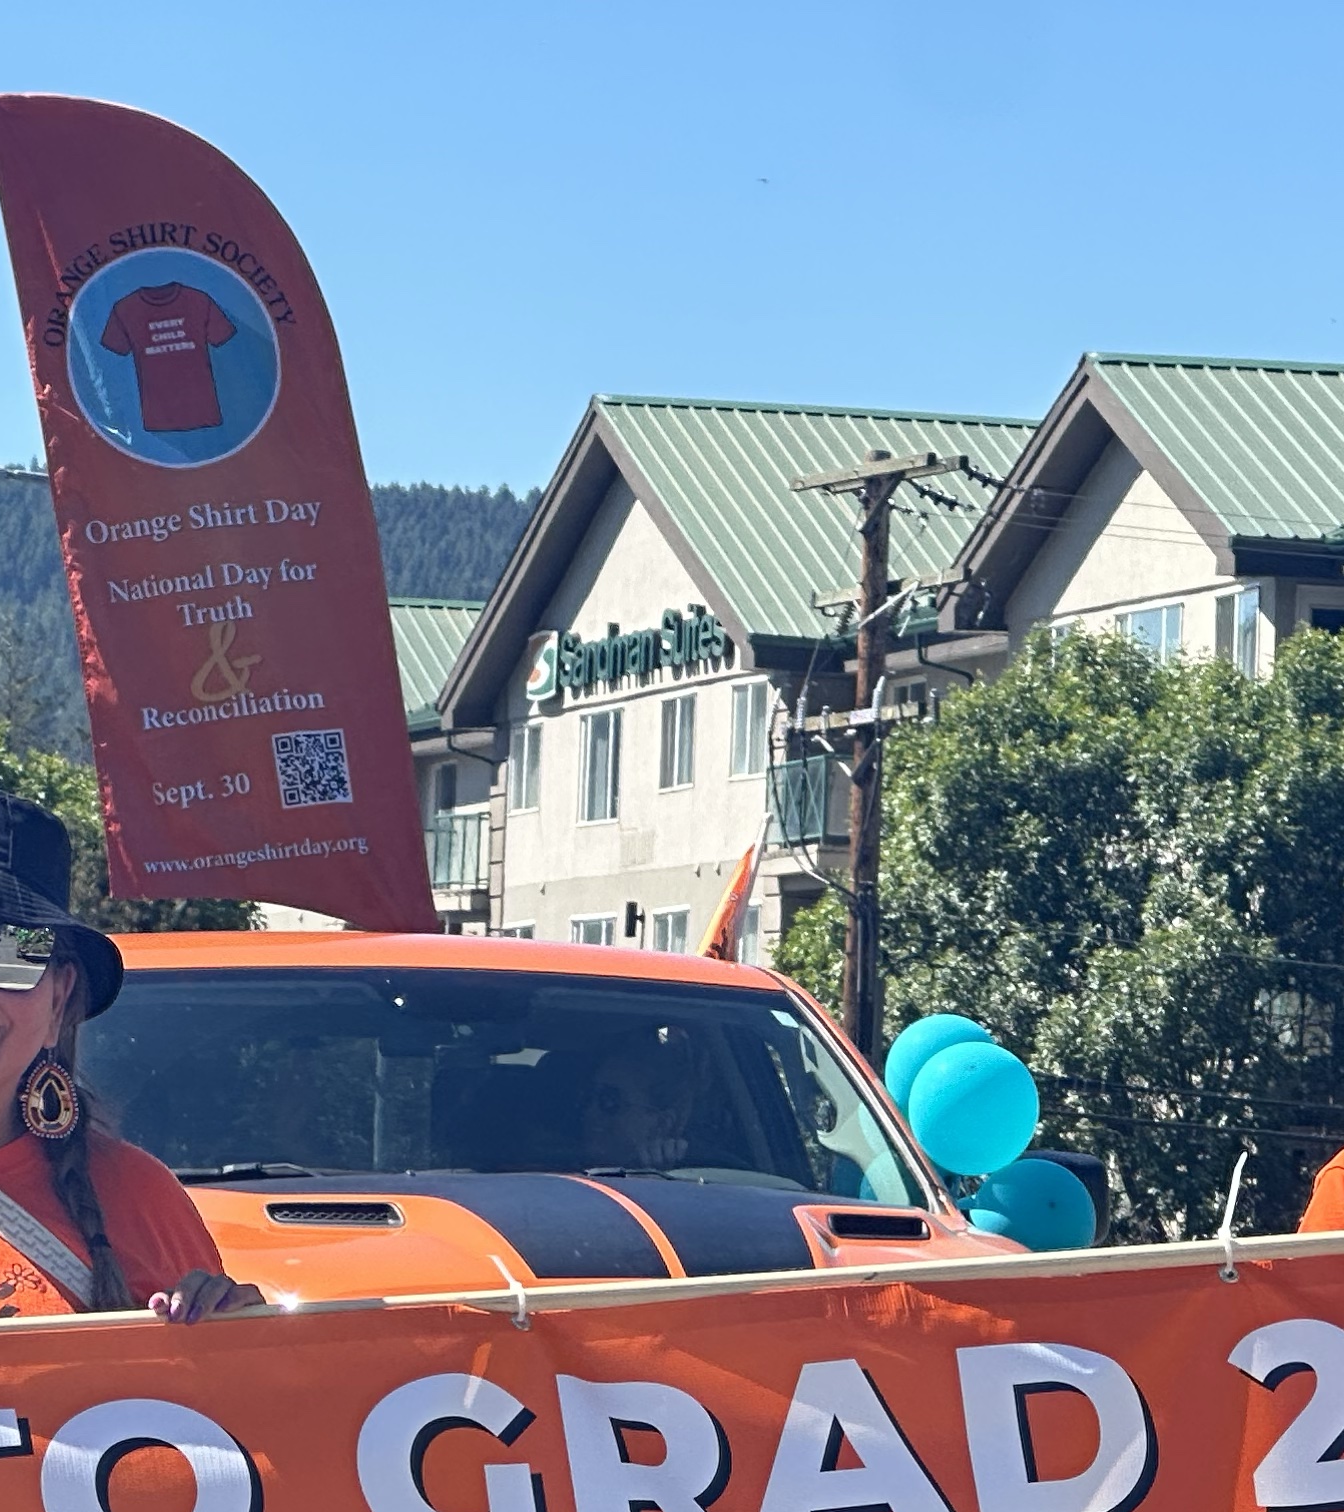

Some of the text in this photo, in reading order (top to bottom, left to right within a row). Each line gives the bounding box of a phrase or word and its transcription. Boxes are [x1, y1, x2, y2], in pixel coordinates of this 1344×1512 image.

[43, 222, 297, 348] ORANGE SHIRT SOCIETY
[85, 499, 322, 544] Orange Shirt Day
[107, 559, 318, 604] National Day for
[176, 596, 254, 628] Truth
[190, 620, 263, 702] &
[558, 603, 728, 688] Sandman Suites
[140, 688, 326, 731] Reconciliation
[152, 772, 251, 810] Sept. 30
[143, 834, 370, 874] www.orangeshirtday.org
